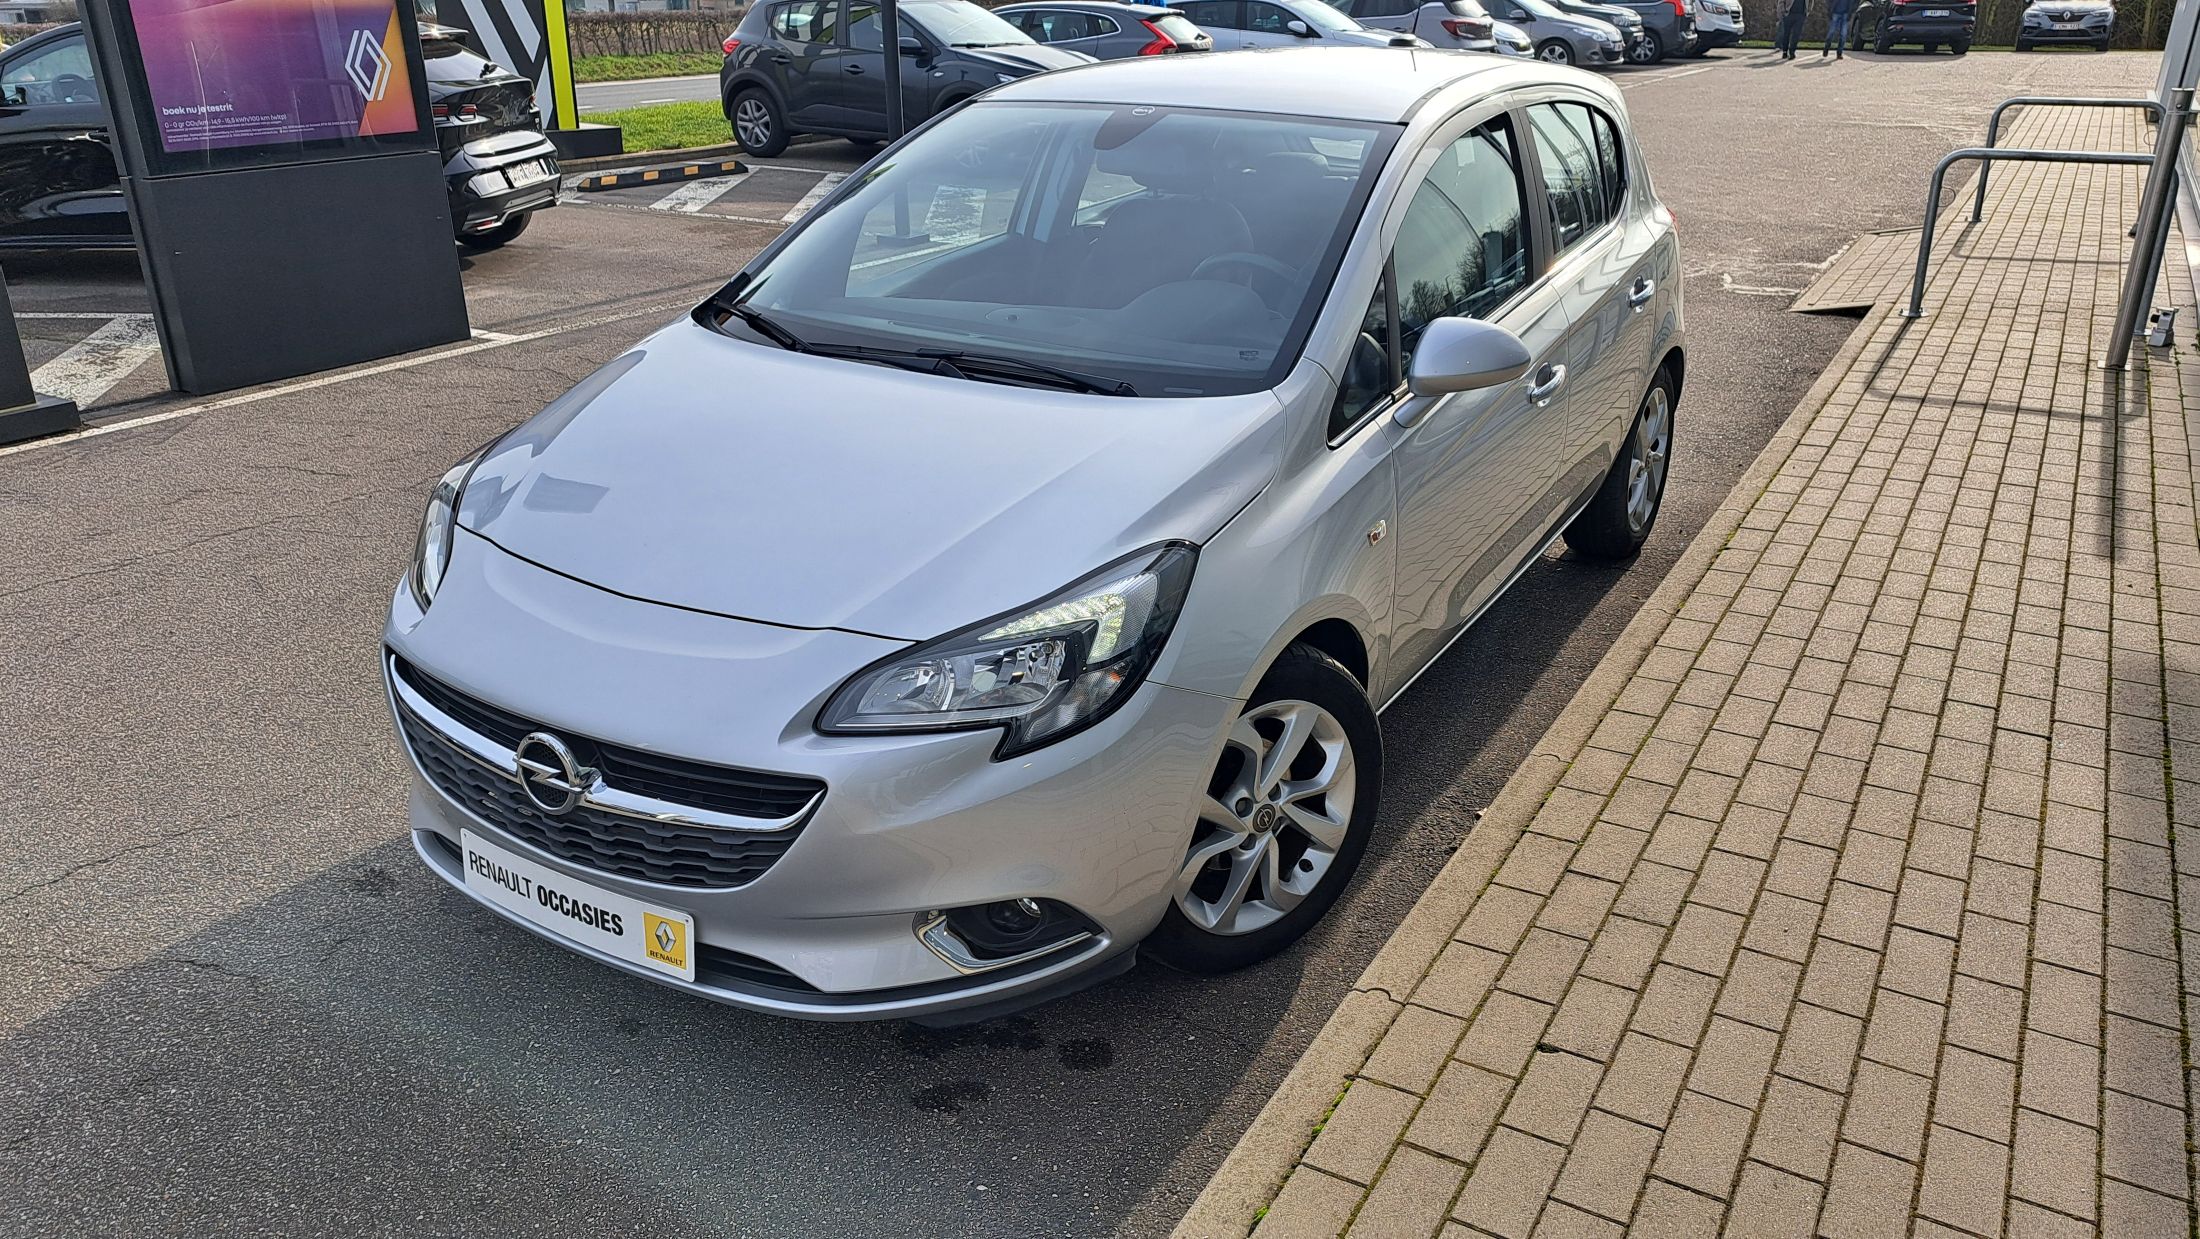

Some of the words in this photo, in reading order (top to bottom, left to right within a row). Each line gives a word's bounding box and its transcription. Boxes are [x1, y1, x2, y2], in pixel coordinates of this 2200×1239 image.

[162, 106, 185, 116] boek
[186, 106, 197, 114] nu
[197, 104, 206, 115] je
[207, 102, 233, 113] testrit
[468, 850, 532, 900] RENAULT
[536, 884, 624, 937] OCCASIES
[649, 949, 683, 968] RENAULT
